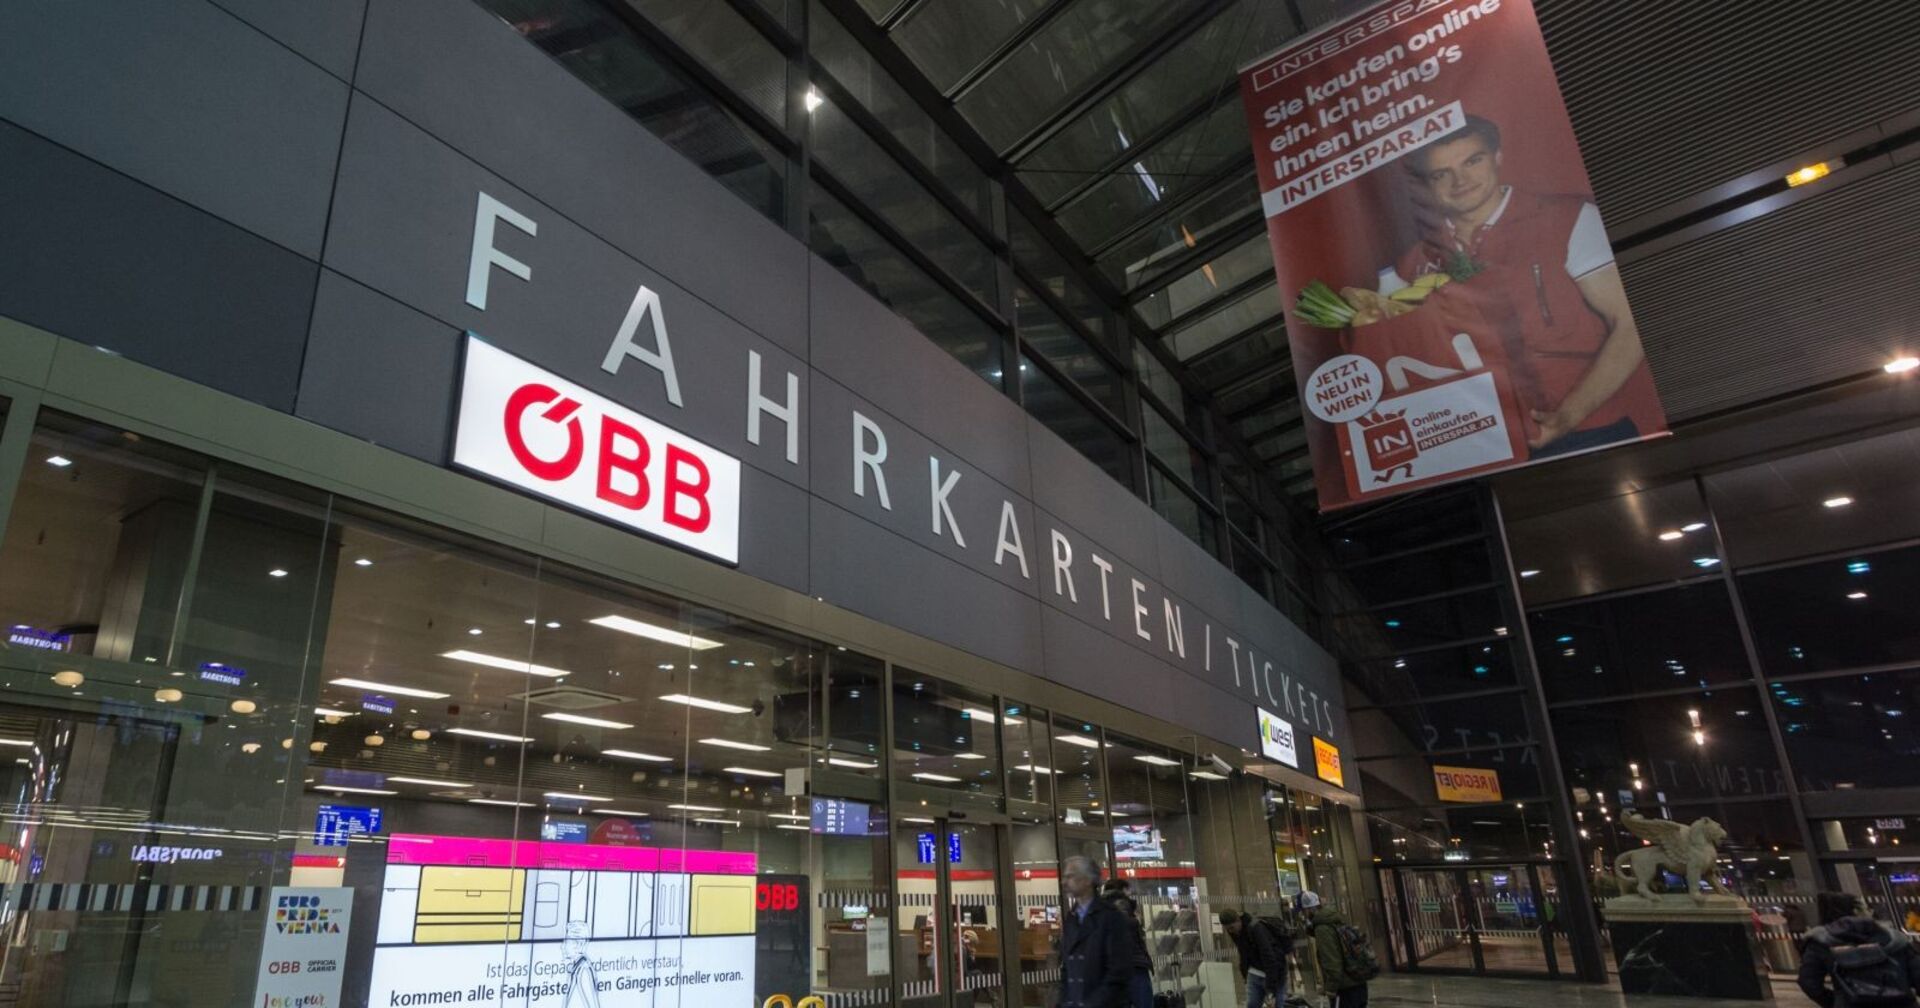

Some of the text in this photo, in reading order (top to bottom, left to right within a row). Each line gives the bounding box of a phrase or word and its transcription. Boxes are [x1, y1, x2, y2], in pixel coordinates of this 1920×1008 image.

[1264, 0, 1501, 128] Sie kaufen online
[1270, 124, 1317, 152] ein.
[1318, 96, 1360, 128] Ich
[1274, 93, 1435, 179] Ihnen heim.
[1281, 109, 1454, 205] INTERSPAR.AT
[1315, 360, 1359, 388] JETZT
[1316, 373, 1370, 404] NEU IN
[1324, 389, 1373, 416] WIEN!
[1412, 408, 1452, 427] Online
[1416, 411, 1478, 438] einkaufen
[1420, 416, 1494, 449] INTERSPAR.AT
[466, 191, 1185, 659] FAHRKARTEN
[1226, 636, 1334, 738] TICKETS
[504, 384, 711, 533] ÖBB
[1270, 723, 1294, 750] west
[276, 908, 329, 921] PRIDE
[278, 896, 320, 907] EURO
[276, 922, 340, 934] VIENNA
[486, 963, 502, 978] Ist
[506, 961, 528, 977] das
[590, 956, 638, 972] rdentlich
[390, 990, 462, 1007] kommen
[467, 985, 495, 1001] alle
[500, 981, 569, 1001] Fahrgäste
[616, 975, 661, 993] Gängen
[665, 970, 711, 988] schneller
[714, 970, 744, 982] voran.
